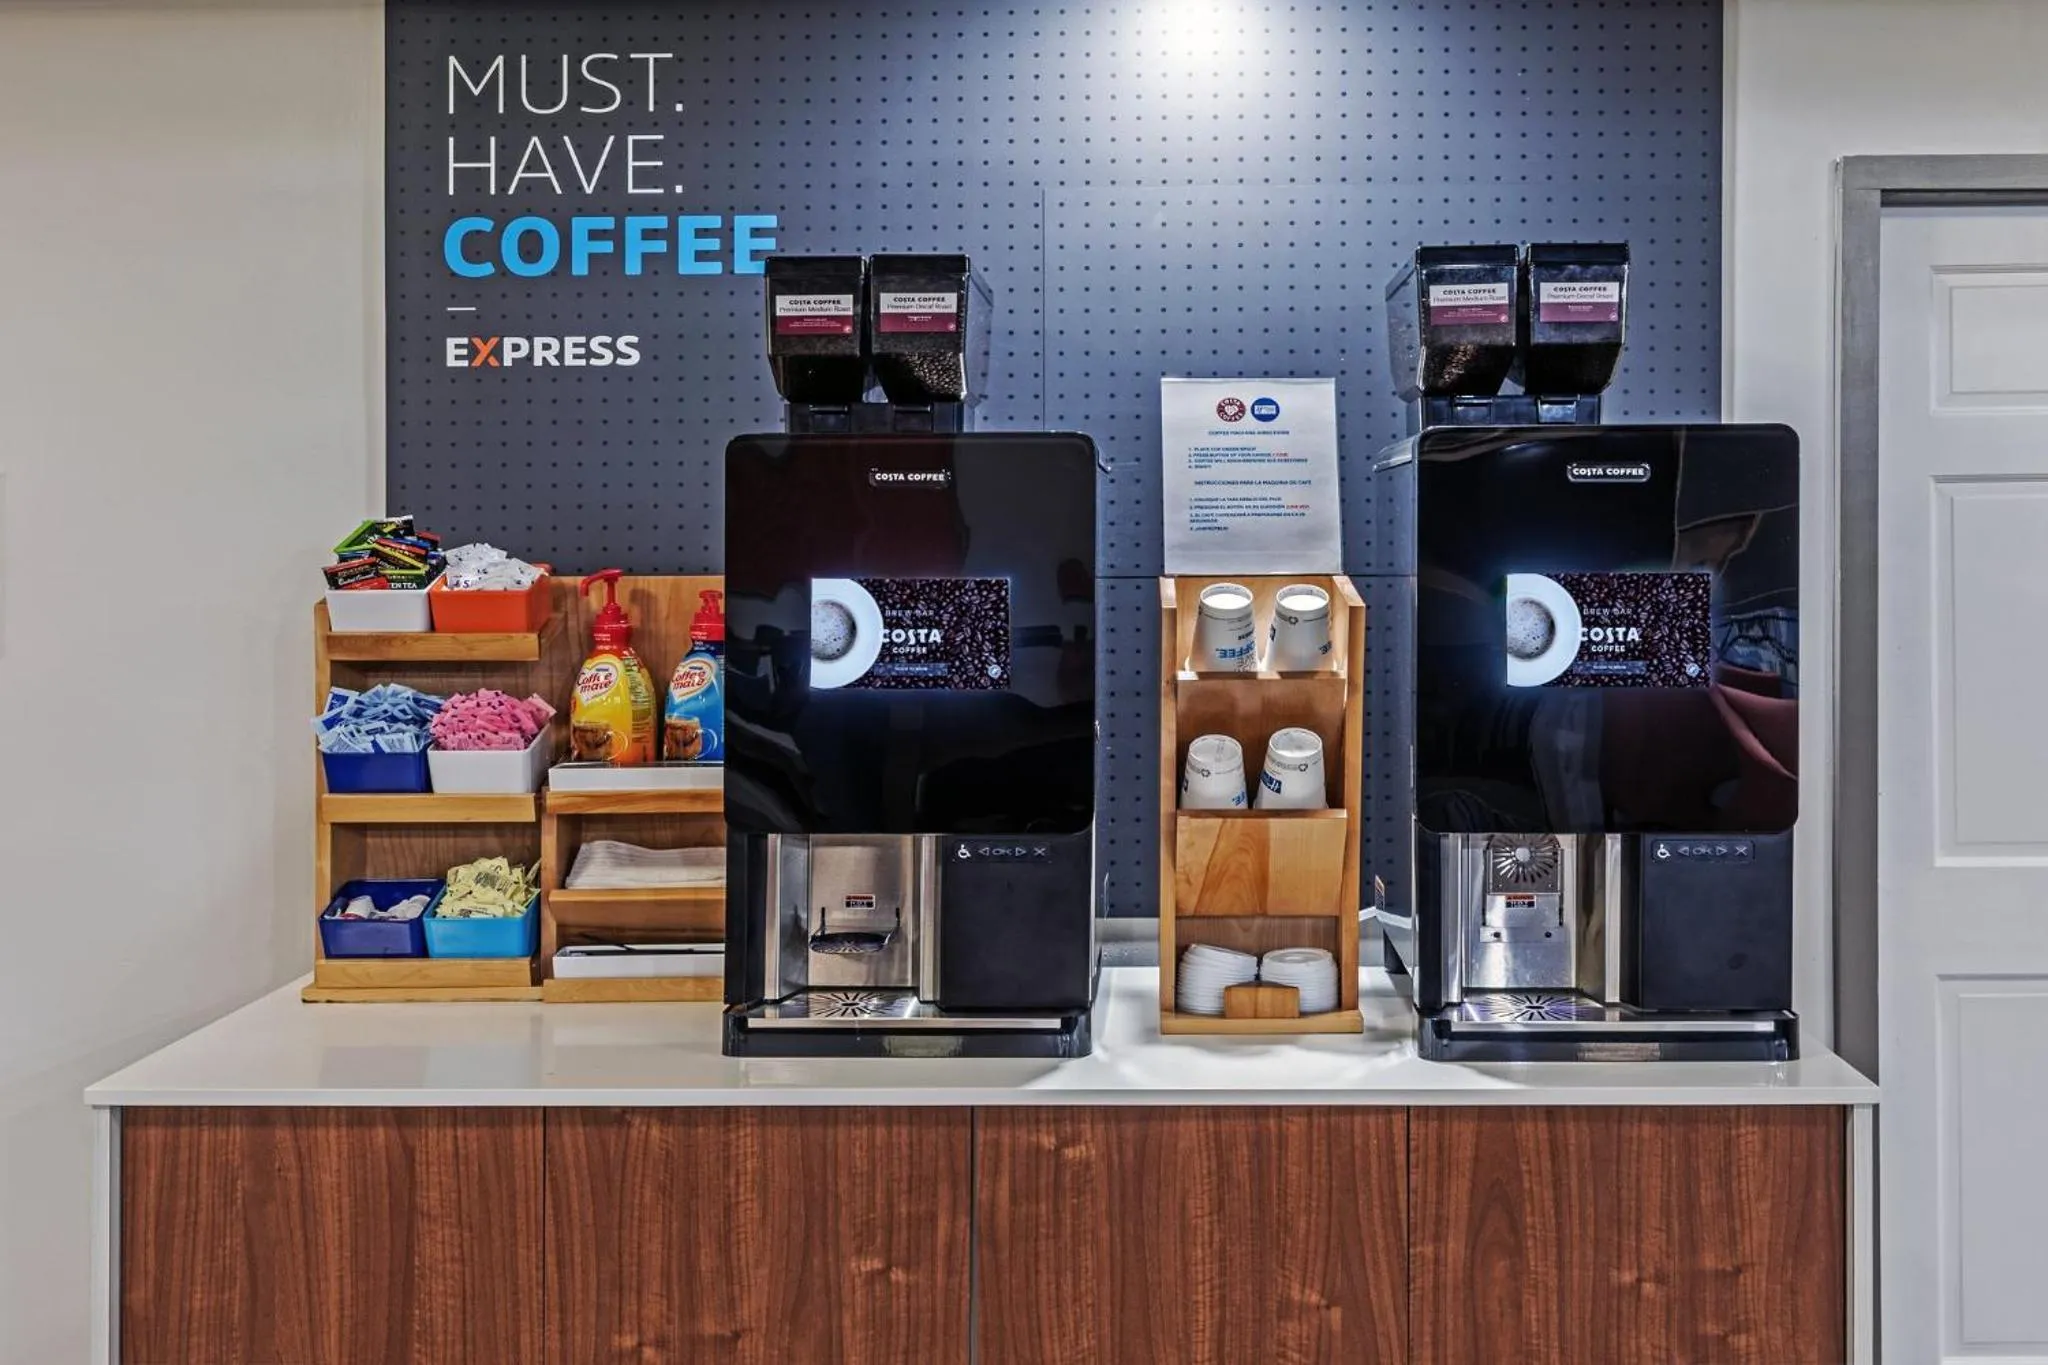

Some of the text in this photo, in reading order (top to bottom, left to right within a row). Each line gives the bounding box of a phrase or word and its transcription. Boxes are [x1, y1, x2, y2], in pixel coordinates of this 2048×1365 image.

[448, 53, 684, 114] MUST.
[448, 135, 684, 195] HAVE.
[443, 214, 778, 278] COFFEE
[446, 335, 641, 367] EXPRESS
[874, 472, 945, 481] COSTA COFFEE
[1572, 467, 1644, 476] COSTA COFFEE
[881, 628, 942, 645] COSTA
[1580, 627, 1640, 643] COSTA
[892, 646, 927, 654] COFFEE
